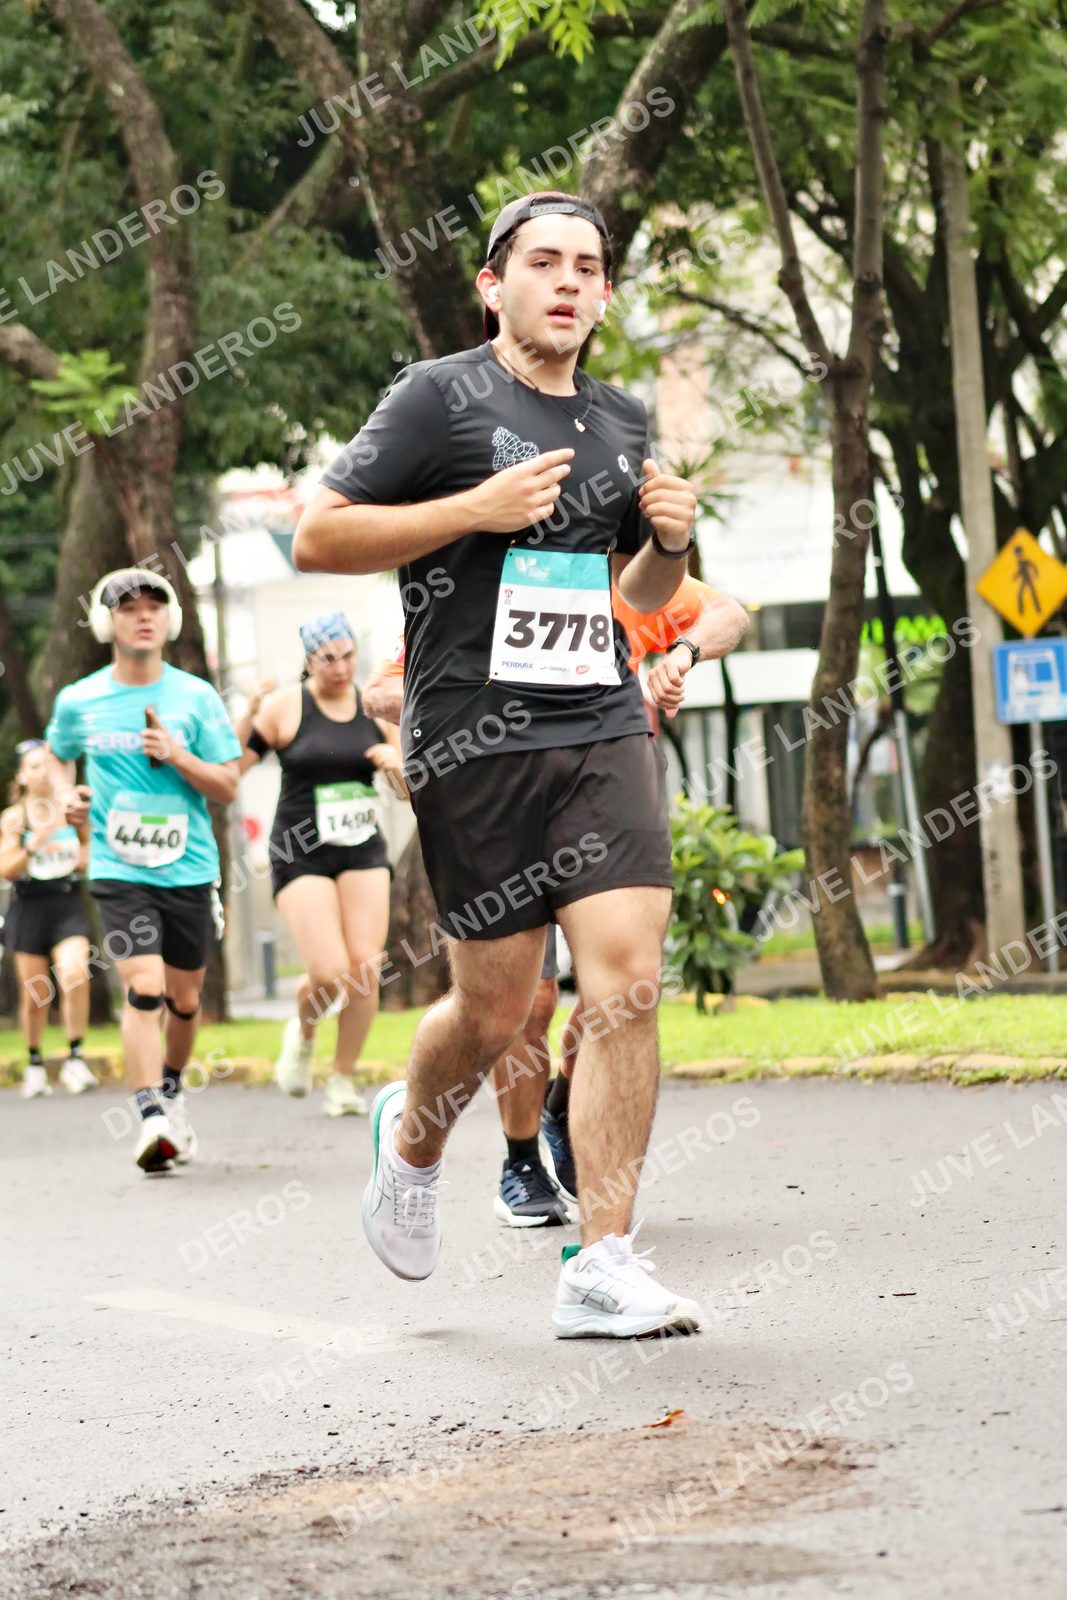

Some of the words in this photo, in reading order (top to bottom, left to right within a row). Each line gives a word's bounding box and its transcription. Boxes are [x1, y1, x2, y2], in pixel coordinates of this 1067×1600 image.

[504, 609, 610, 653] 3778
[502, 661, 534, 670] PERDURA
[114, 825, 181, 849] 4440
